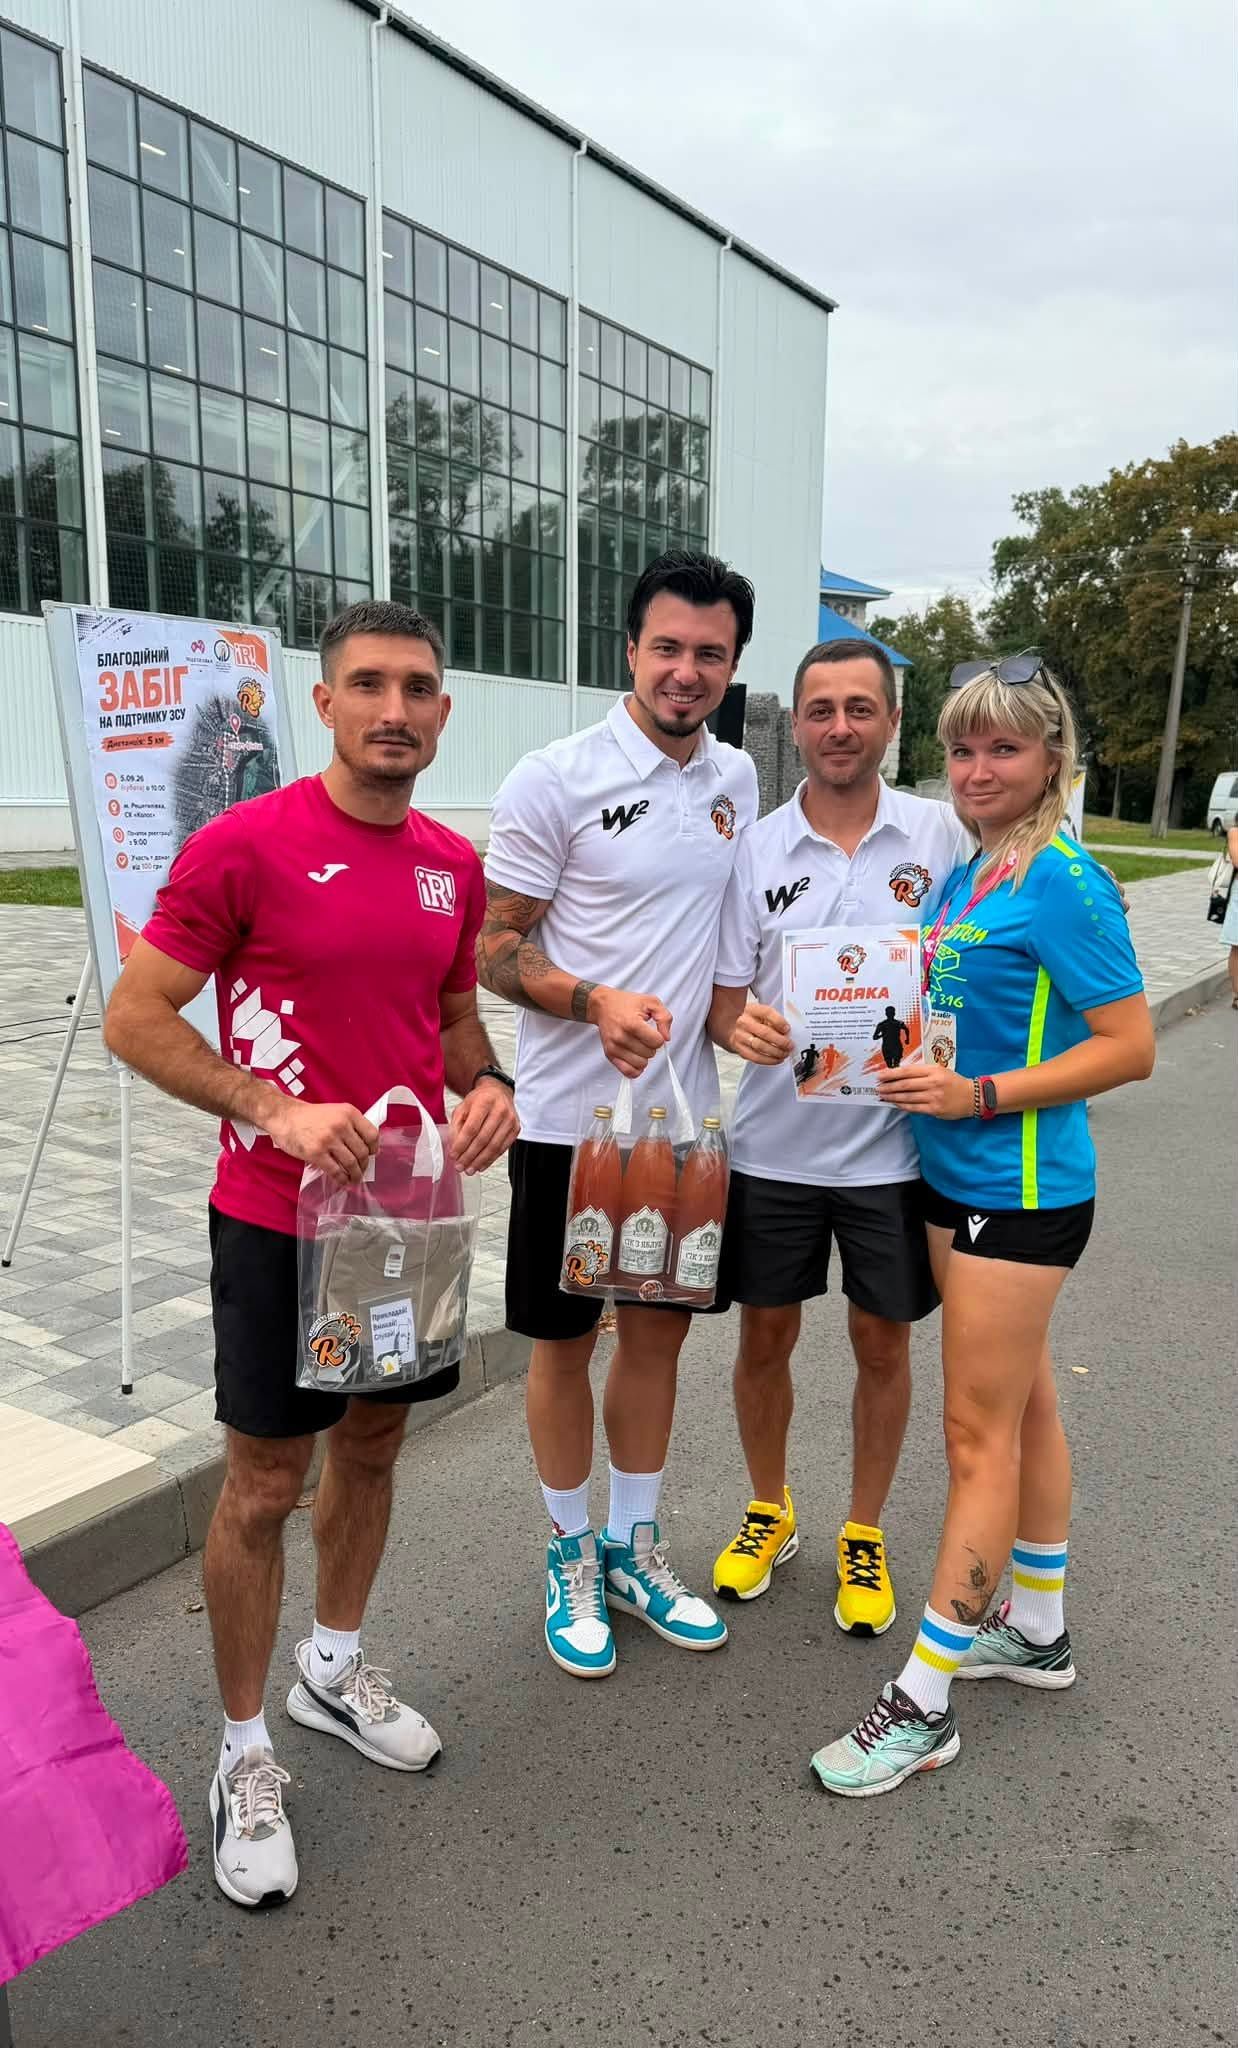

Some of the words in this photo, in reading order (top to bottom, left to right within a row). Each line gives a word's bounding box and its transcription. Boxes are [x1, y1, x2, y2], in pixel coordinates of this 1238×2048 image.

[97, 647, 170, 667] БЛАГОДІЙНИЙ
[98, 666, 189, 712] ЗАБІГ
[99, 715, 113, 729] НА
[115, 710, 168, 729] ПІДТРИМКУ
[169, 708, 187, 722] ЗСУ
[147, 735, 153, 745] 5
[154, 737, 165, 745] км
[815, 987, 890, 1002] ПОДЯКА
[310, 1336, 346, 1367] R
